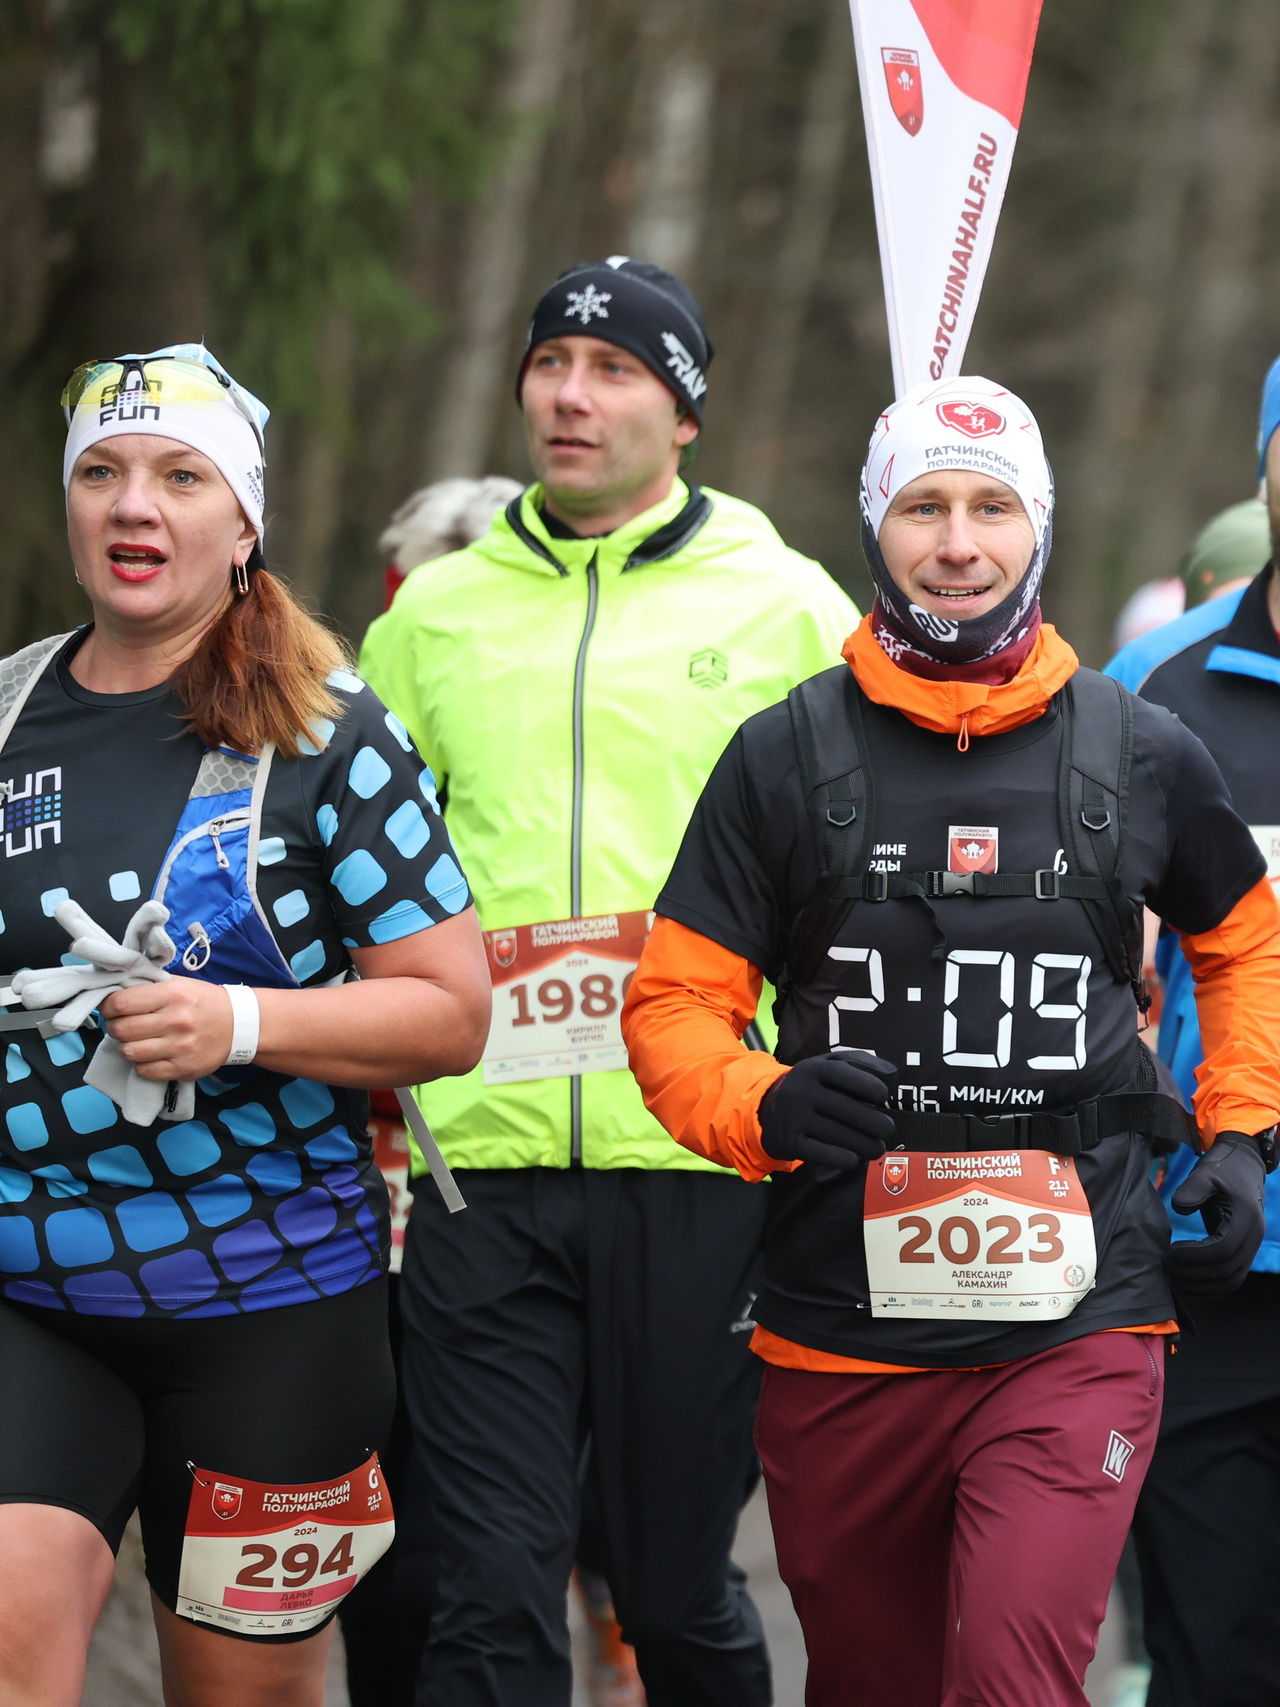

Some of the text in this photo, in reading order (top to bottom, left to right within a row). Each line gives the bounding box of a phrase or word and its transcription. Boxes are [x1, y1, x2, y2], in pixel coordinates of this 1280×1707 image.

[100, 405, 160, 426] FUN
[925, 445, 1019, 476] ГАТЧИНСКИЙ
[927, 458, 1018, 485] ПОЛУМАРАФОН
[7, 766, 62, 803] UN
[0, 820, 61, 858] UN
[532, 914, 619, 938] ГАТЧИНСКИЙ
[534, 928, 620, 947] ПОЛУМАРАФОН
[827, 946, 1092, 1070] 2:09
[950, 1085, 1045, 1105] МИН/КМ
[926, 1153, 1021, 1170] ГАТЧИНСКИЙ
[1048, 1157, 1062, 1175] F
[927, 1168, 1022, 1179] ПОЛУМАРАФОН
[1048, 1180, 1070, 1191] 21.1
[963, 1198, 989, 1206] 2024
[897, 1213, 1064, 1265] 2023
[951, 1270, 1013, 1280] АЛЕКСАНДР
[957, 1280, 1008, 1289] КАМАХИН
[368, 1468, 379, 1489] G
[263, 1480, 351, 1504] ГАТЧИНСКИЙ
[367, 1491, 382, 1506] 21.1
[262, 1493, 350, 1513] ПОЛУМАРАФОН
[294, 1526, 318, 1536] 2024
[235, 1531, 354, 1588] 294
[279, 1598, 312, 1609] ЛЕВКО
[280, 1589, 314, 1602] ДАРЬЯ
